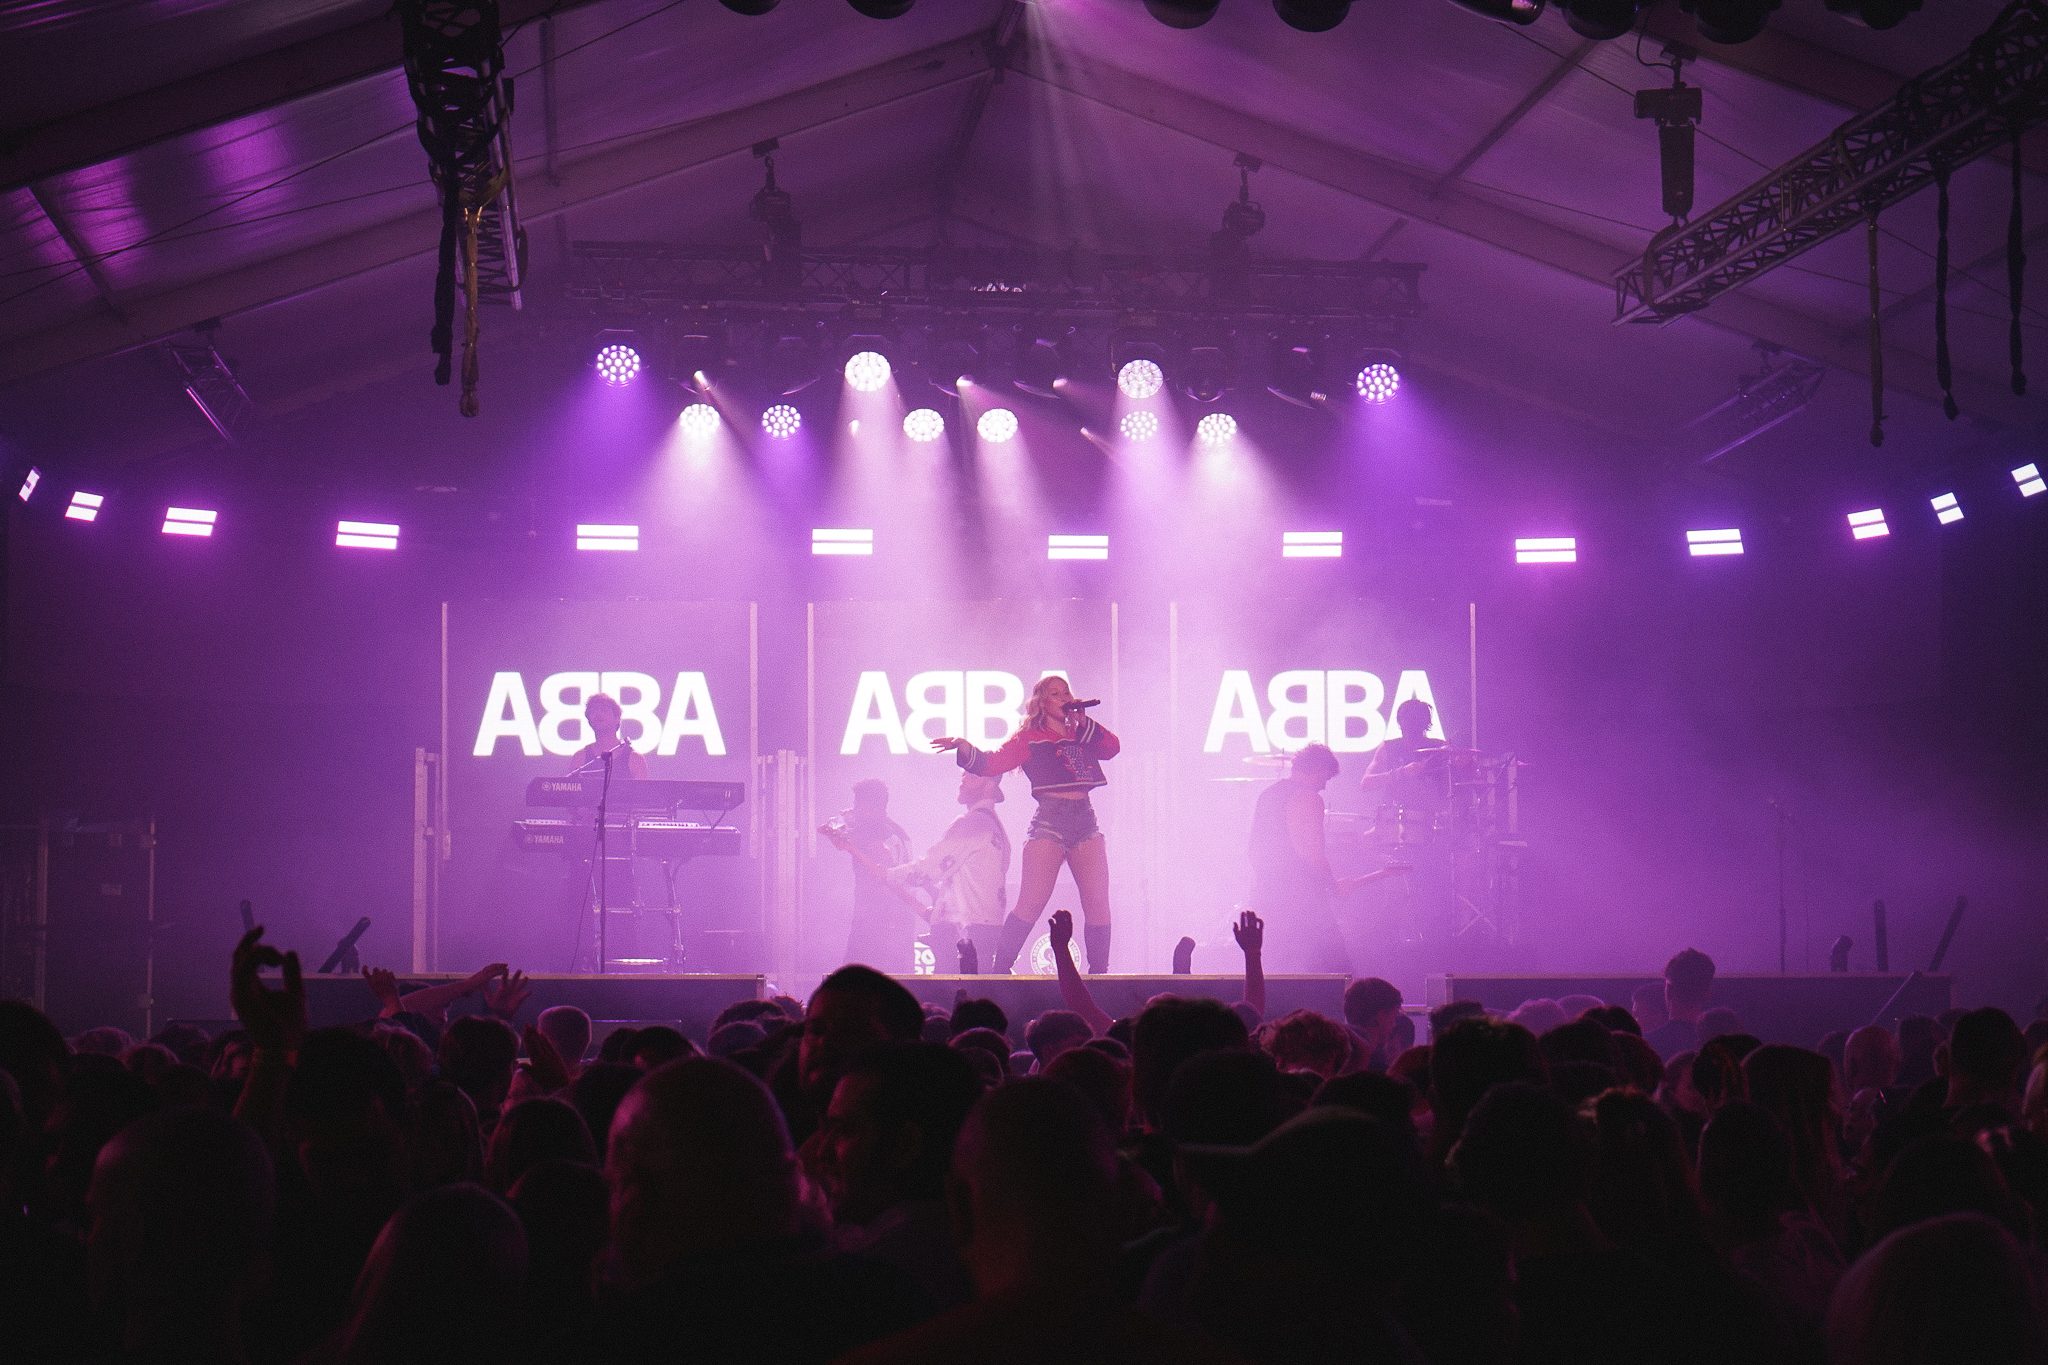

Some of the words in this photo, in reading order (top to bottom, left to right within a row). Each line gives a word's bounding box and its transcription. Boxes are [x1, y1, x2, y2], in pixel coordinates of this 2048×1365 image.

[840, 670, 1073, 755] ABB
[551, 782, 582, 792] YAMAHA
[534, 835, 564, 844] YAMAHA
